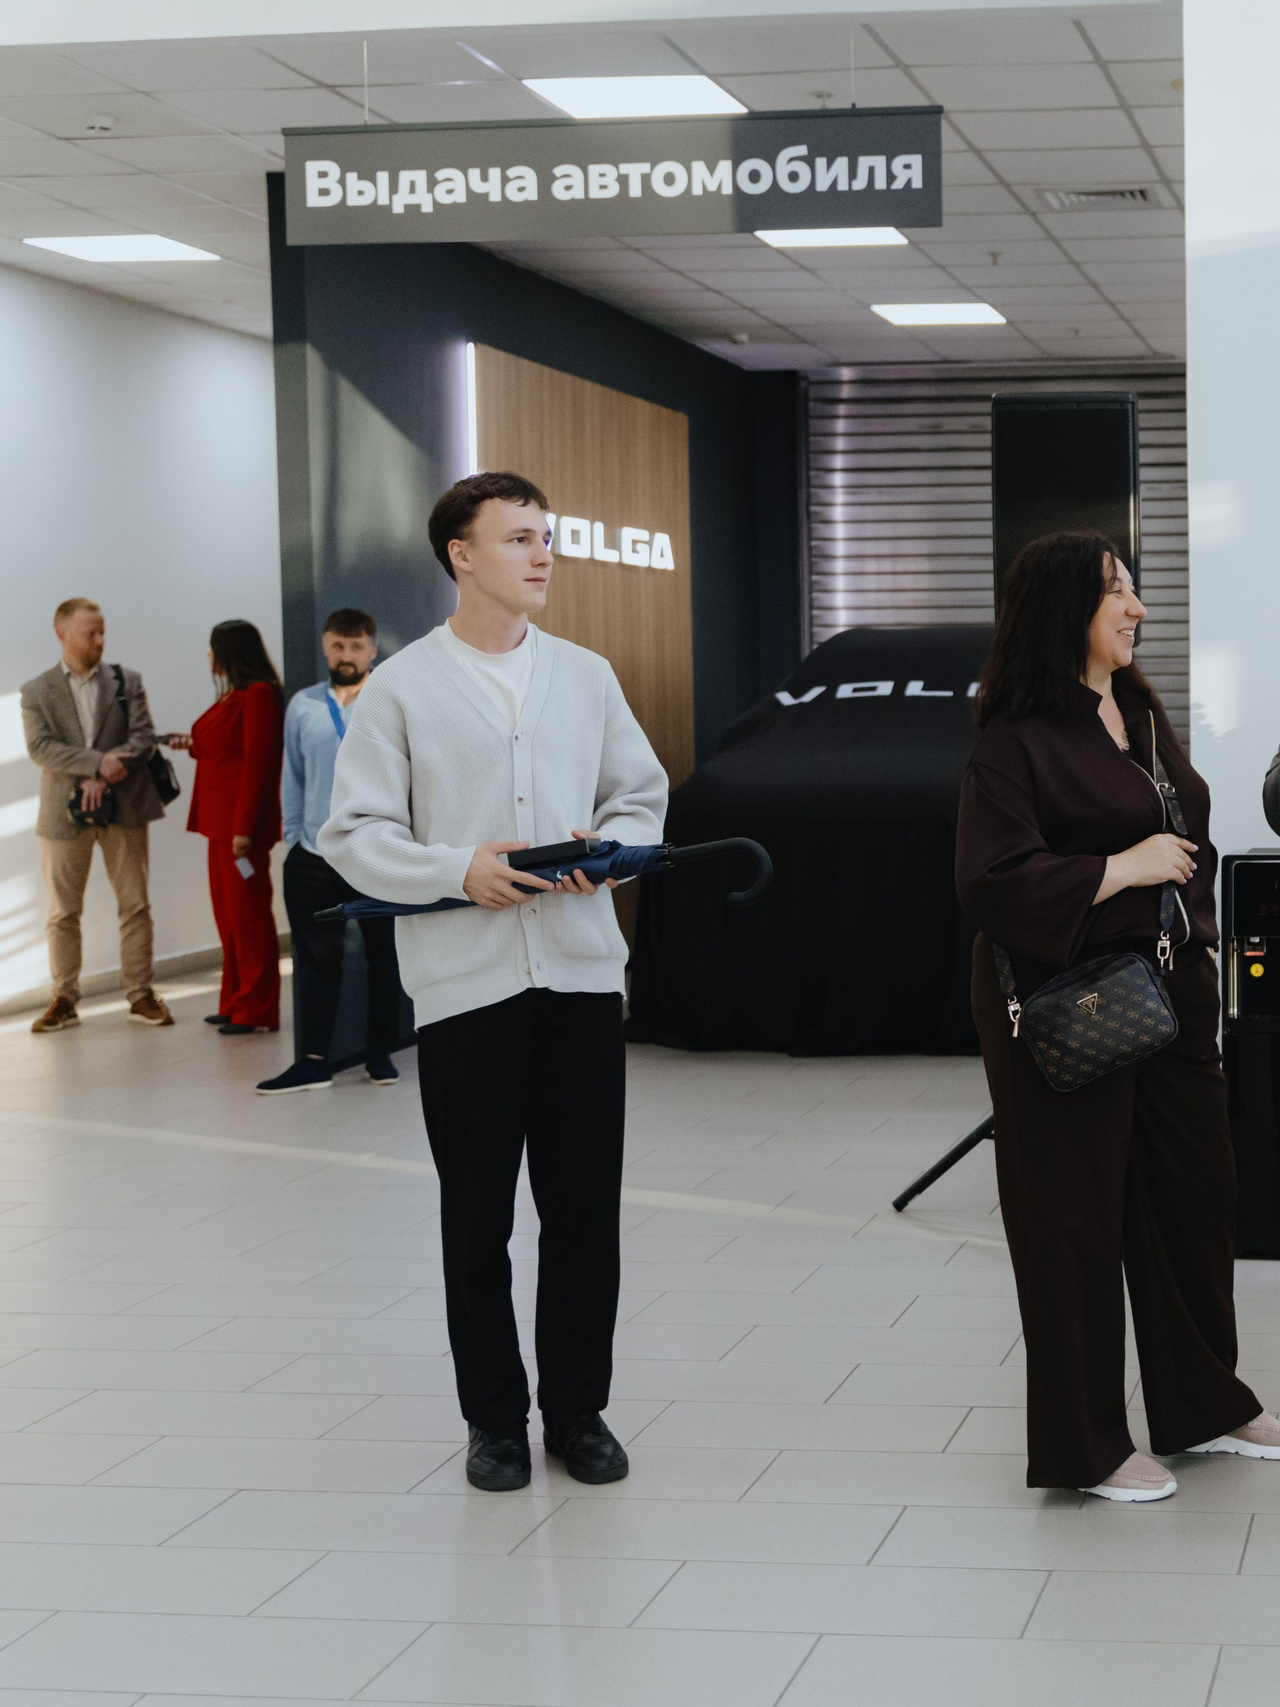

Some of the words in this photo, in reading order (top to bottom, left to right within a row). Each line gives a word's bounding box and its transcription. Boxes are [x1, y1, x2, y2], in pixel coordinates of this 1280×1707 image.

[304, 160, 538, 214] Выдача
[550, 144, 923, 201] автомобиля
[775, 680, 982, 706] VOL
